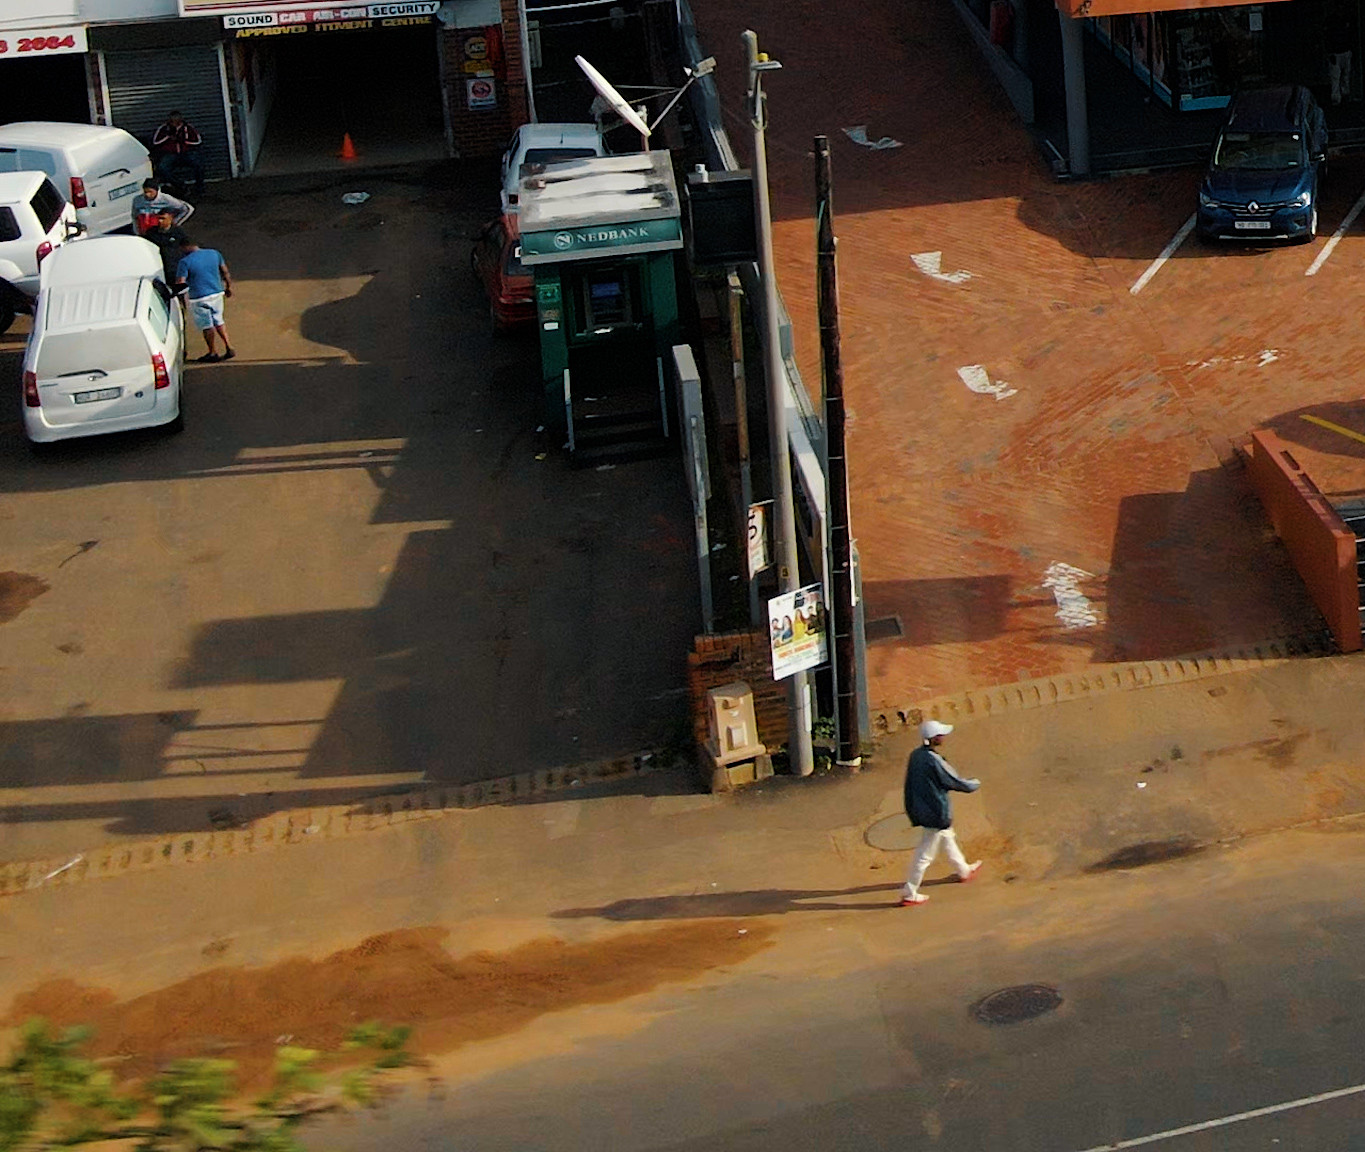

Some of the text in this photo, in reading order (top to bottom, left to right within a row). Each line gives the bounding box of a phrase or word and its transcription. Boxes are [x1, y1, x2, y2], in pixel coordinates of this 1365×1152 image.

[228, 14, 273, 27] SOUND
[372, 2, 436, 16] SECURITY
[236, 24, 308, 39] APPROVED
[381, 16, 433, 28] CENTRE
[576, 227, 649, 244] NEDBANK
